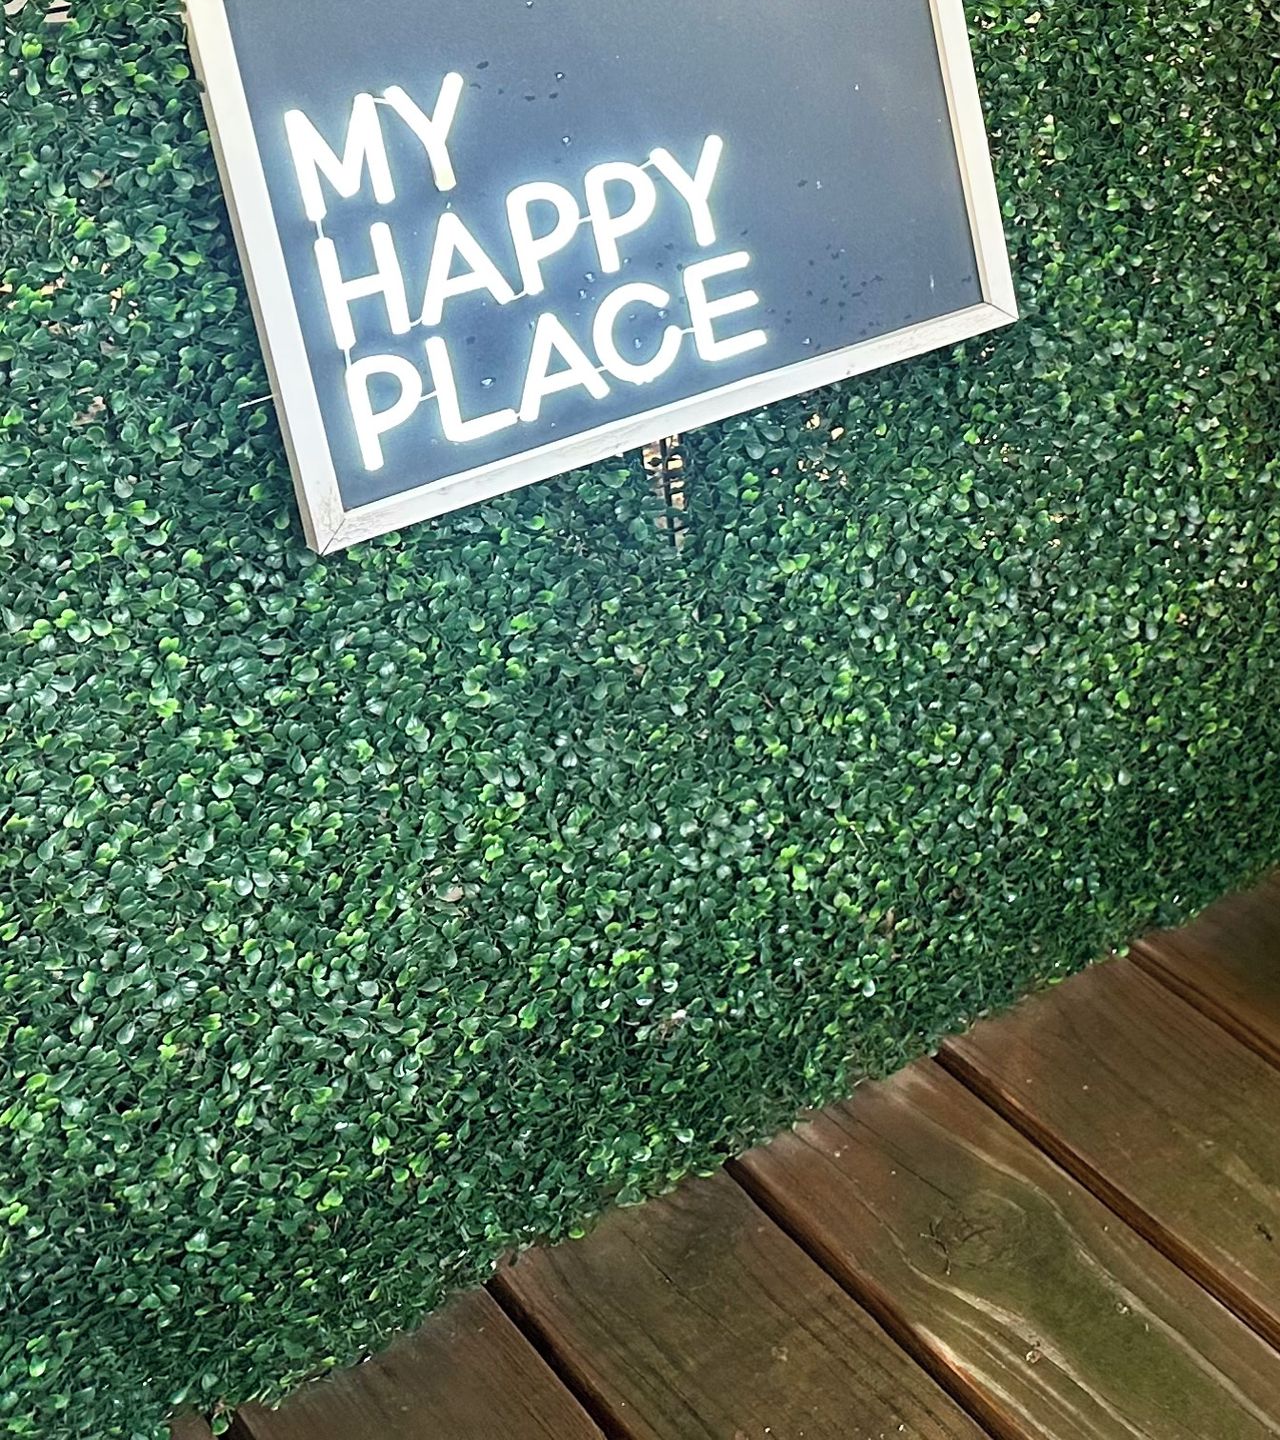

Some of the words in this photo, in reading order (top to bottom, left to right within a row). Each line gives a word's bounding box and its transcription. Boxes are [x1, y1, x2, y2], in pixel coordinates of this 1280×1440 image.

[284, 71, 463, 222] MY
[314, 134, 723, 351] HAPPY
[344, 252, 769, 471] PLACE
